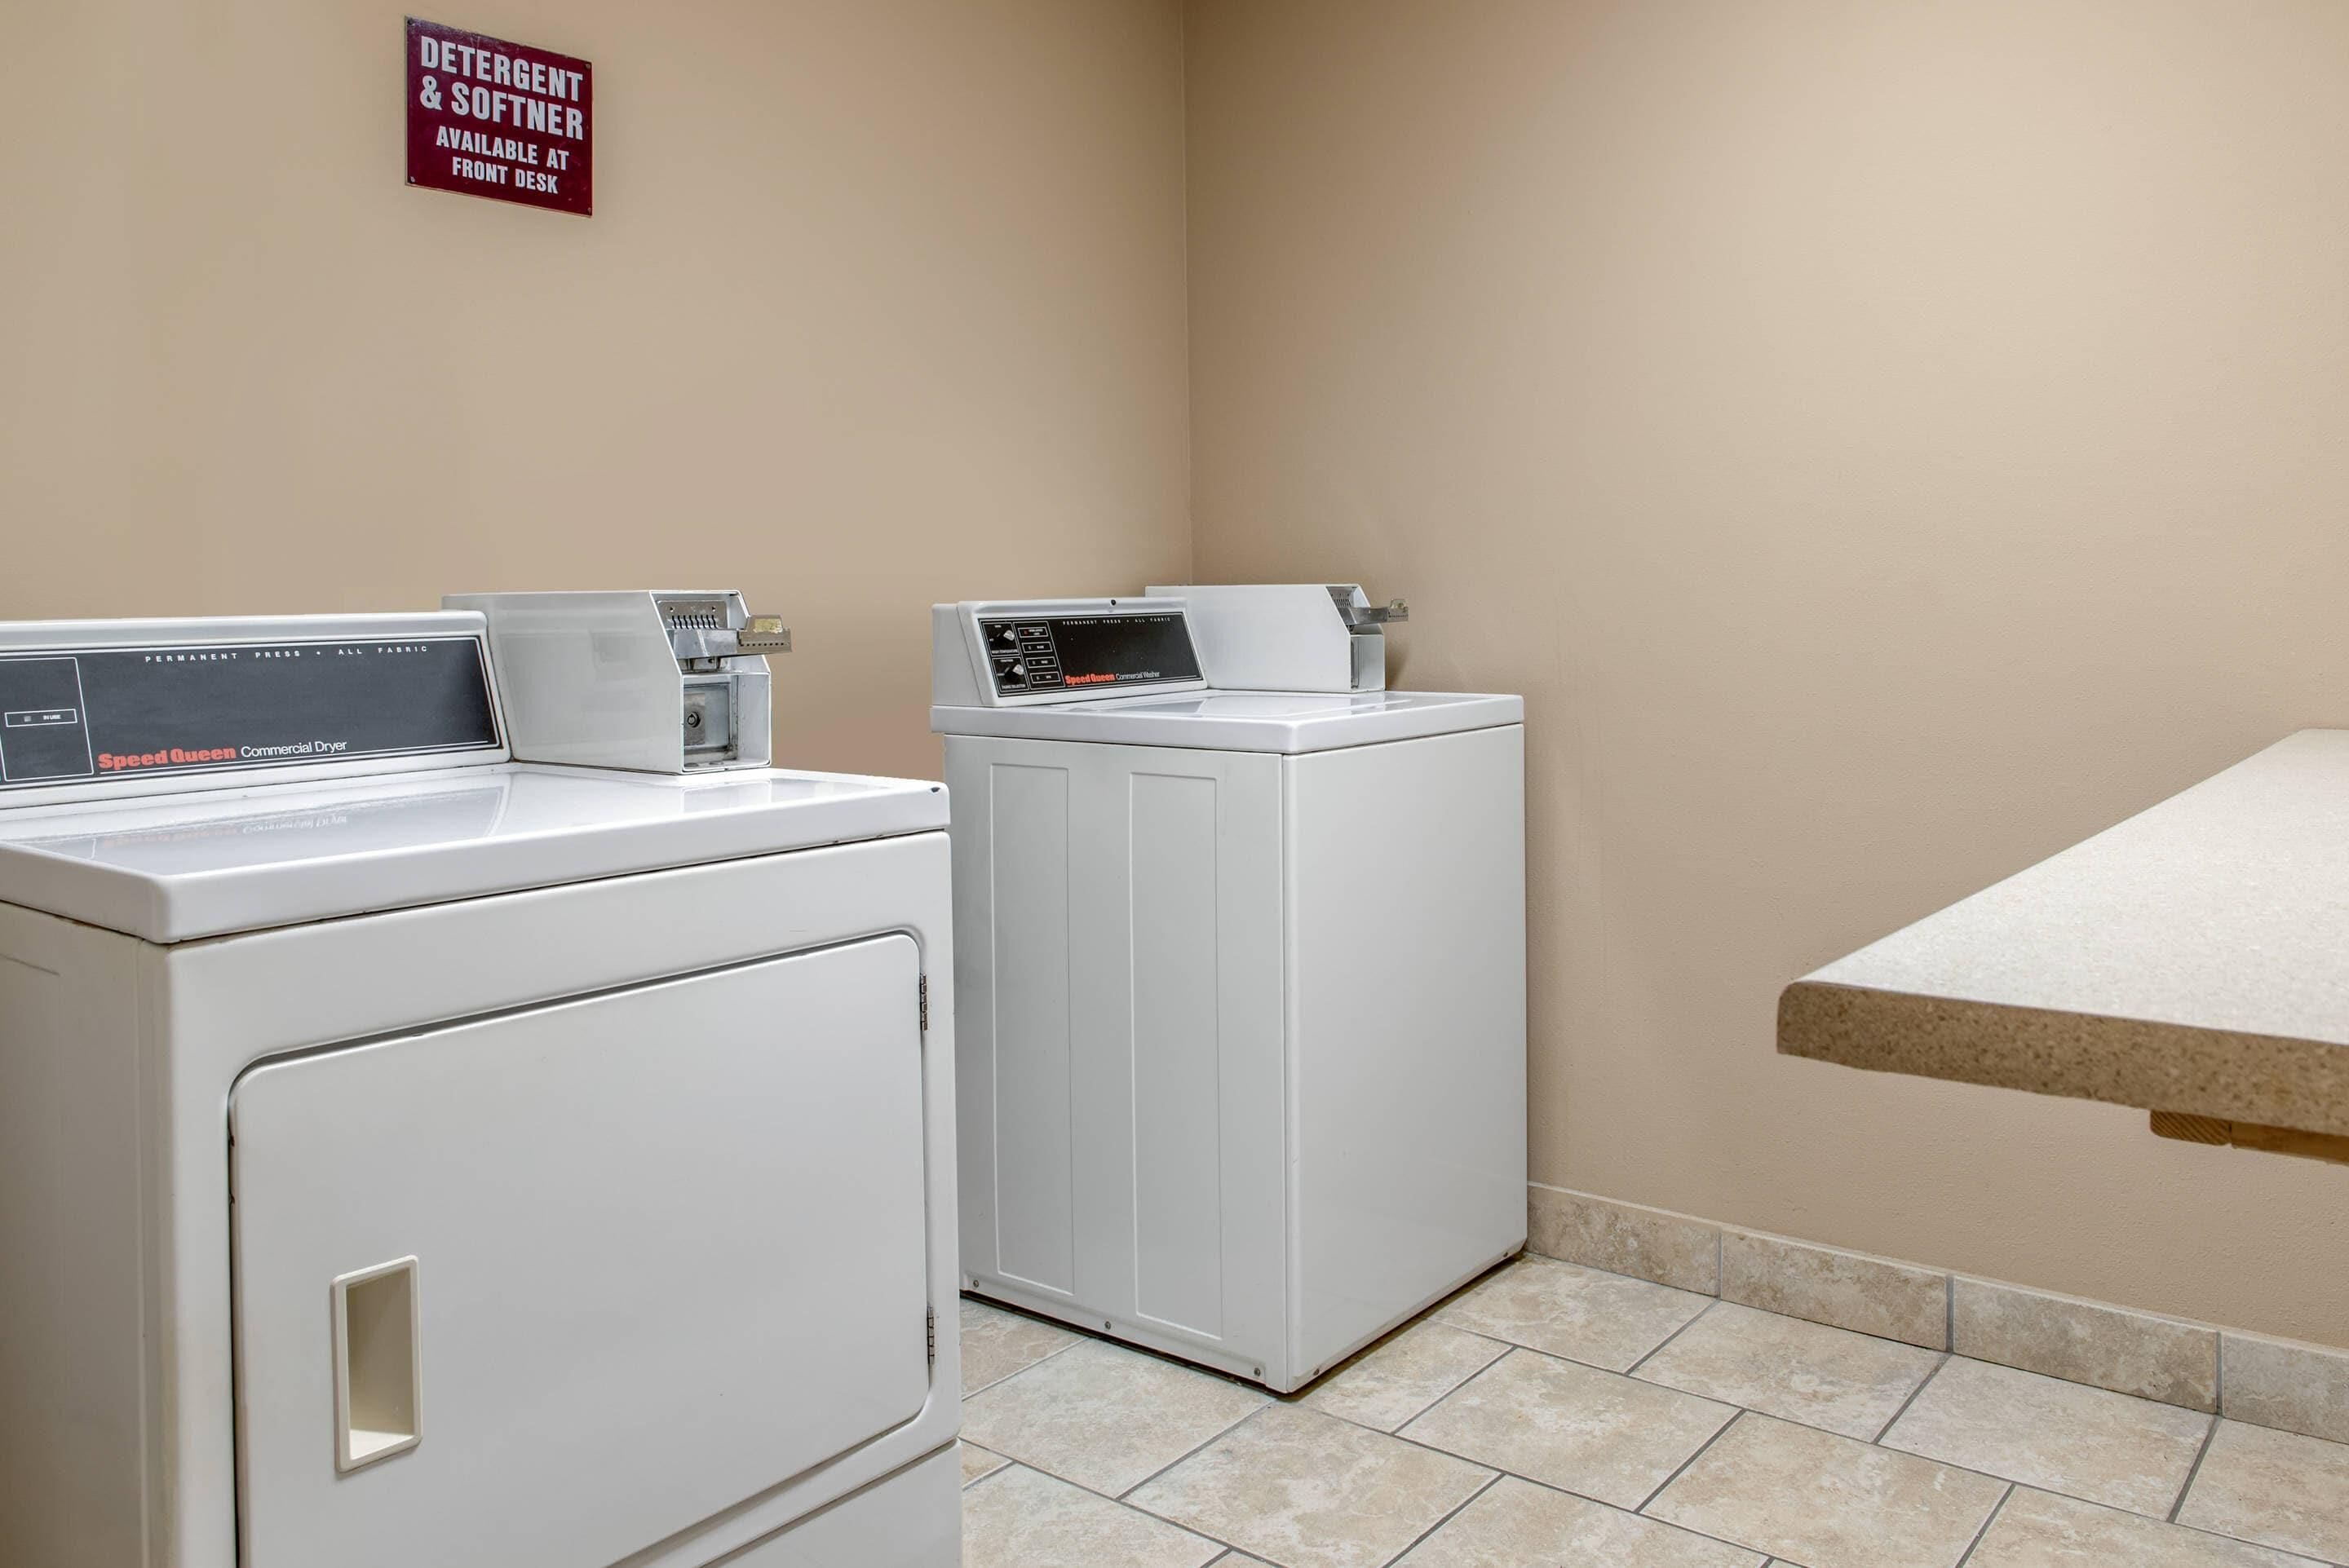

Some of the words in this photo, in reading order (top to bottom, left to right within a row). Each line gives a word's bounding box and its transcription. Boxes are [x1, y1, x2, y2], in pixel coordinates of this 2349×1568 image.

[421, 35, 584, 103] DETERGENT
[419, 75, 443, 111] &
[451, 82, 584, 141] SOFTNER
[436, 125, 538, 166] AVAILABLE
[546, 148, 570, 171] AT
[452, 156, 509, 185] FRONT
[515, 168, 559, 195] DESK
[144, 652, 237, 663] PERMANENT
[254, 651, 300, 659] PRESS
[378, 646, 427, 654] FABRIC
[1064, 672, 1090, 685] Speed
[1090, 673, 1116, 682] Queen
[1116, 672, 1143, 681] Commercial
[97, 749, 169, 771] Speed
[170, 748, 237, 763] Queen
[241, 741, 313, 757] Commercial
[314, 740, 347, 753] Dryer
